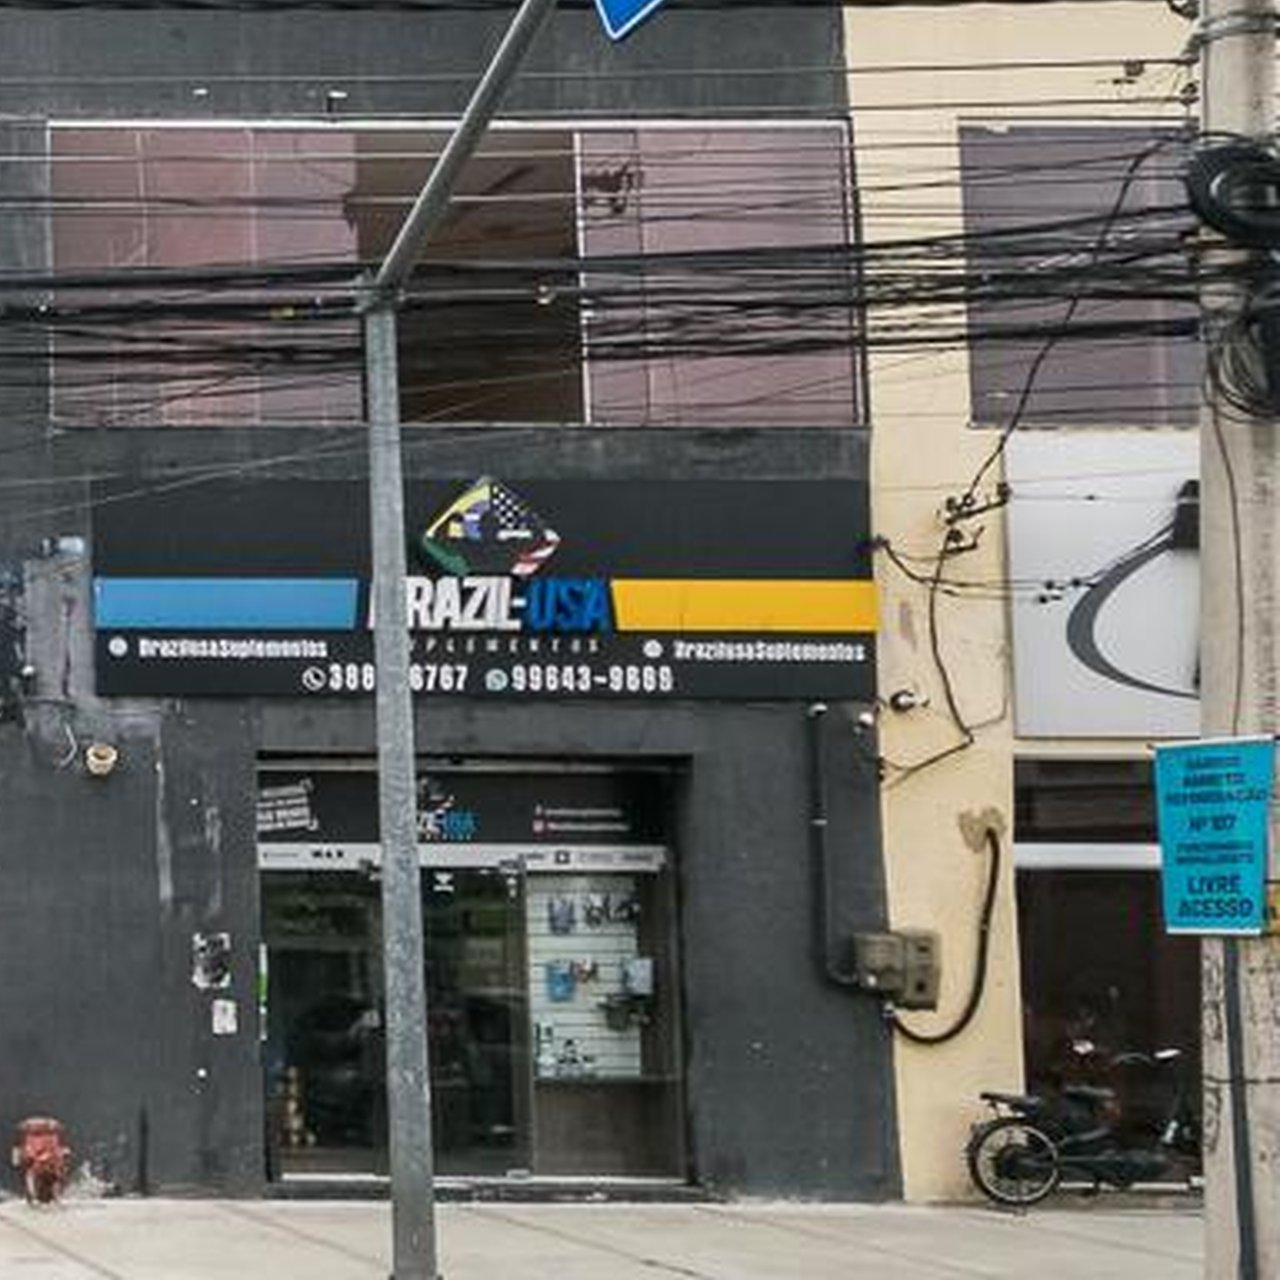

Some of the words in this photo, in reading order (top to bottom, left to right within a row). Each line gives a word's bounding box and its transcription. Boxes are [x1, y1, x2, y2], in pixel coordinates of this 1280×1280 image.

[368, 576, 608, 631] RAZIL-USA
[329, 663, 468, 691] 3886767
[1187, 874, 1242, 895] LIVRE
[1178, 898, 1254, 919] ACESSO
